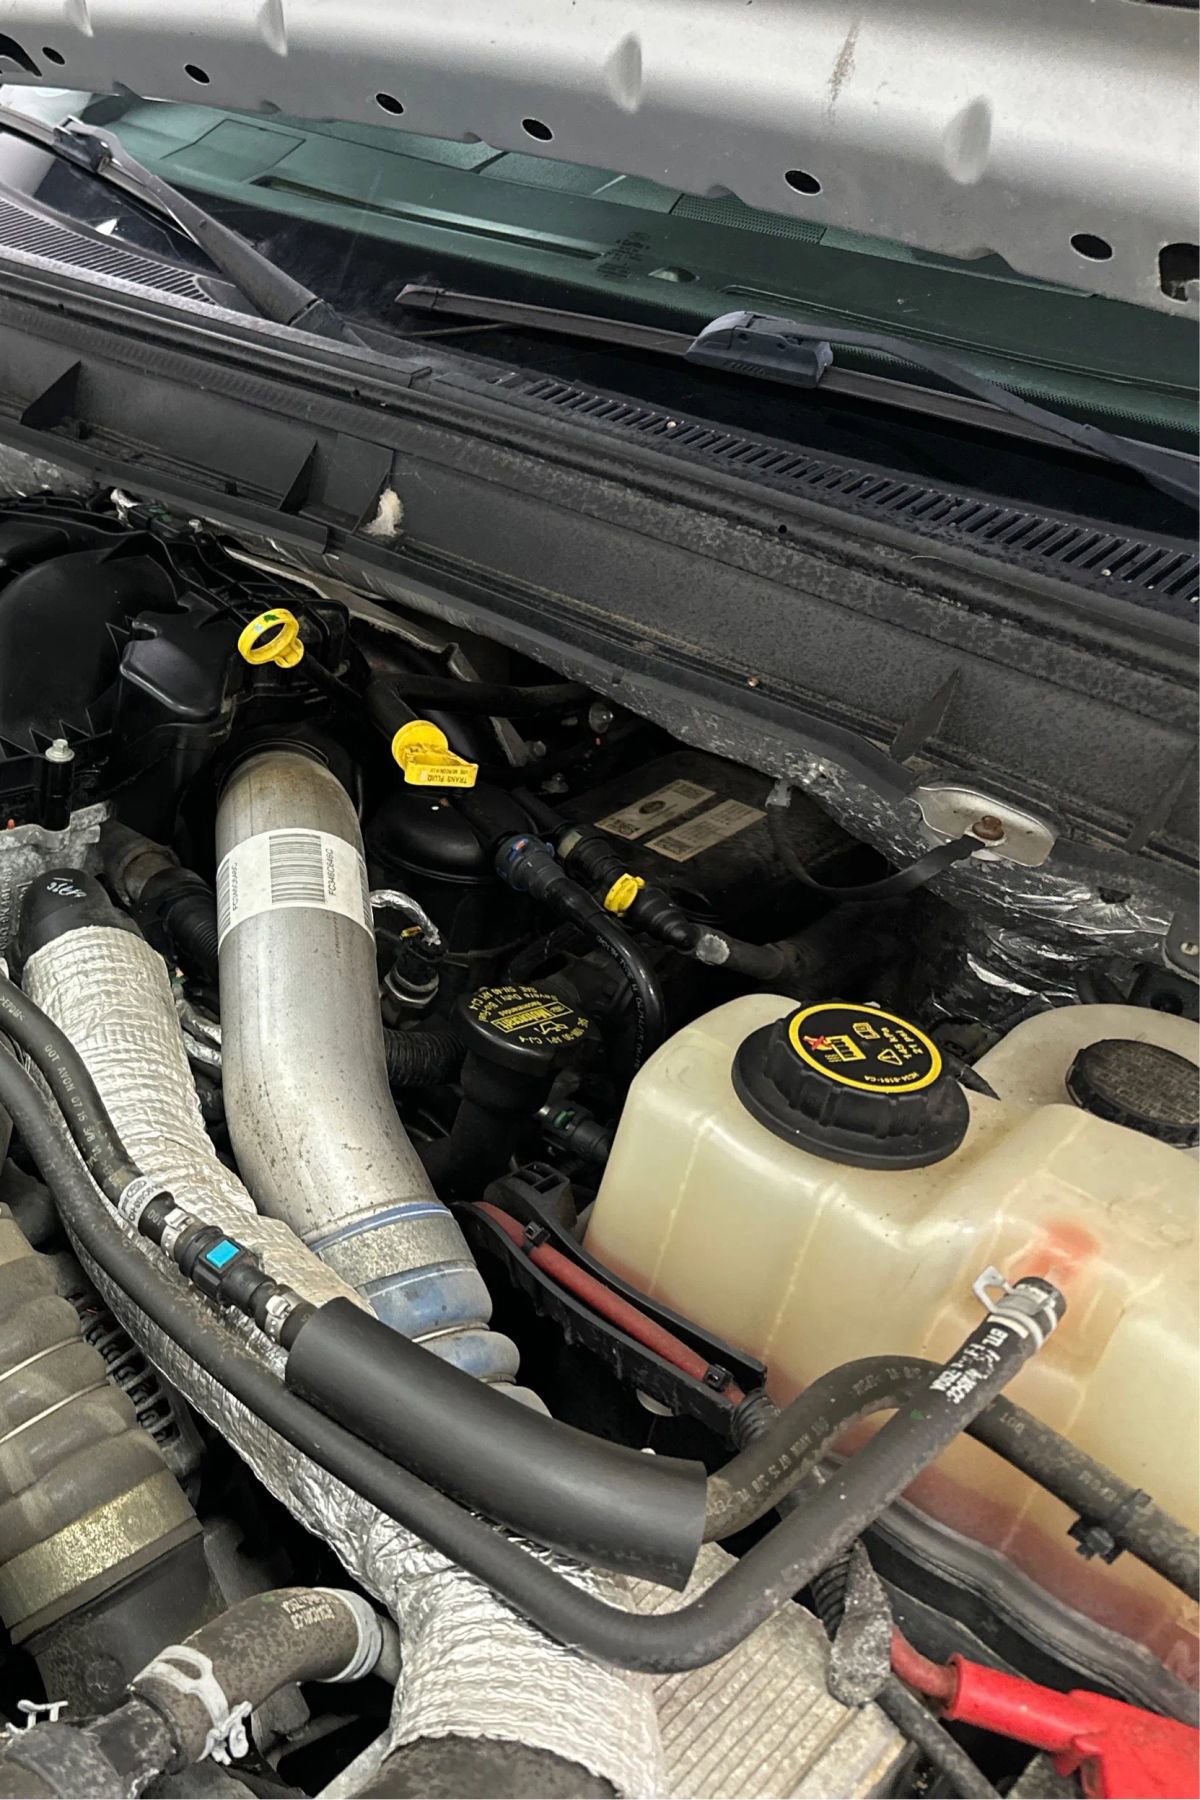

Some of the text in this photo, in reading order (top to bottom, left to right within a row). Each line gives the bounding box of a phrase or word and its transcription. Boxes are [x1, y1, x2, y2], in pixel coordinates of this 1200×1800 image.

[326, 848, 336, 896] FC346C646C
[0, 994, 25, 1022] >EPDM<
[499, 1008, 552, 1029] Motorcraft
[518, 1035, 543, 1045] CJ-4
[44, 1044, 59, 1063] DOT
[57, 1066, 75, 1092] AVON
[70, 1095, 82, 1109] 07
[76, 1110, 88, 1122] 15
[82, 1126, 96, 1143] 3/8
